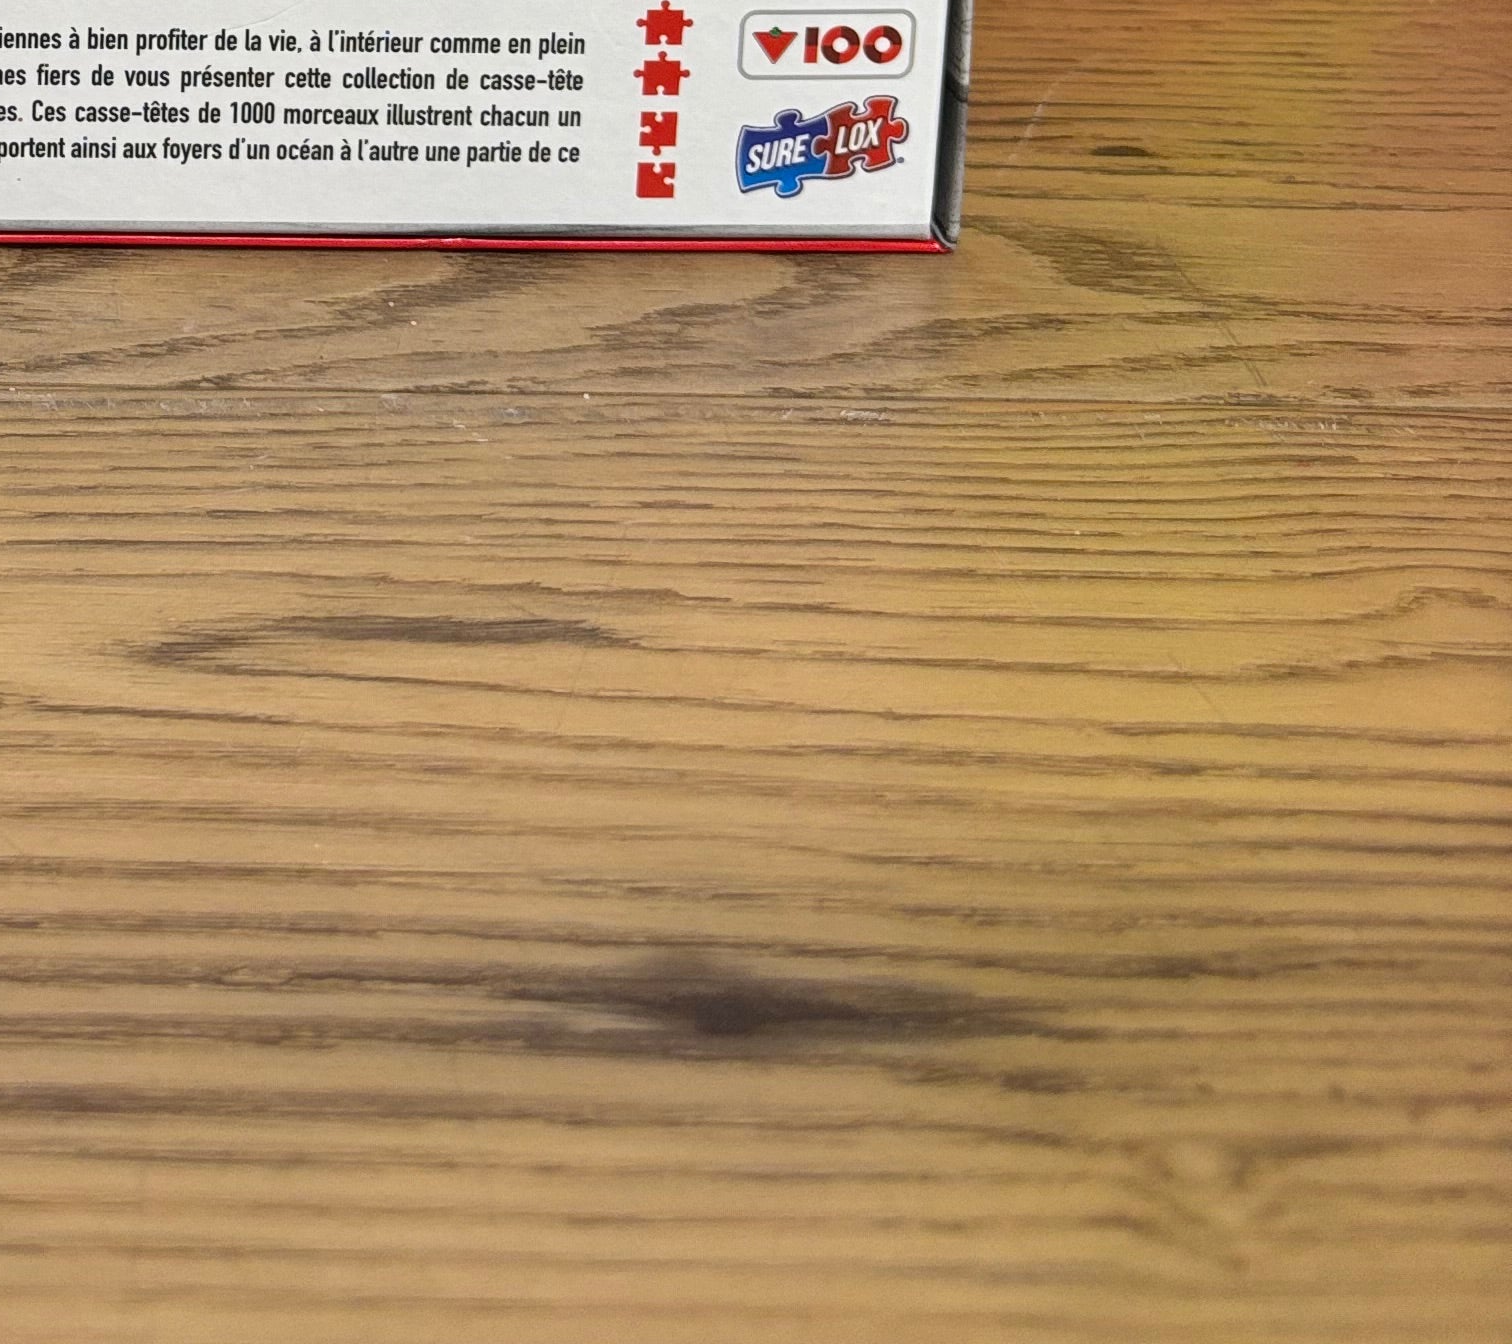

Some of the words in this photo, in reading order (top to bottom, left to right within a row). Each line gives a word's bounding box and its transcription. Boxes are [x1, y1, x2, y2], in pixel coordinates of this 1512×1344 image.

[69, 27, 79, 49] à
[88, 27, 128, 49] bien
[136, 28, 208, 56] profiter
[215, 29, 237, 50] de
[245, 29, 261, 51] la
[269, 30, 301, 53] vie,
[310, 30, 320, 51] à
[329, 30, 423, 52] l'intérieur
[431, 37, 500, 53] comme
[509, 38, 530, 53] en
[539, 32, 585, 60] plein
[803, 25, 903, 65] 100
[747, 134, 810, 173] SURE
[835, 117, 884, 154] LOX
